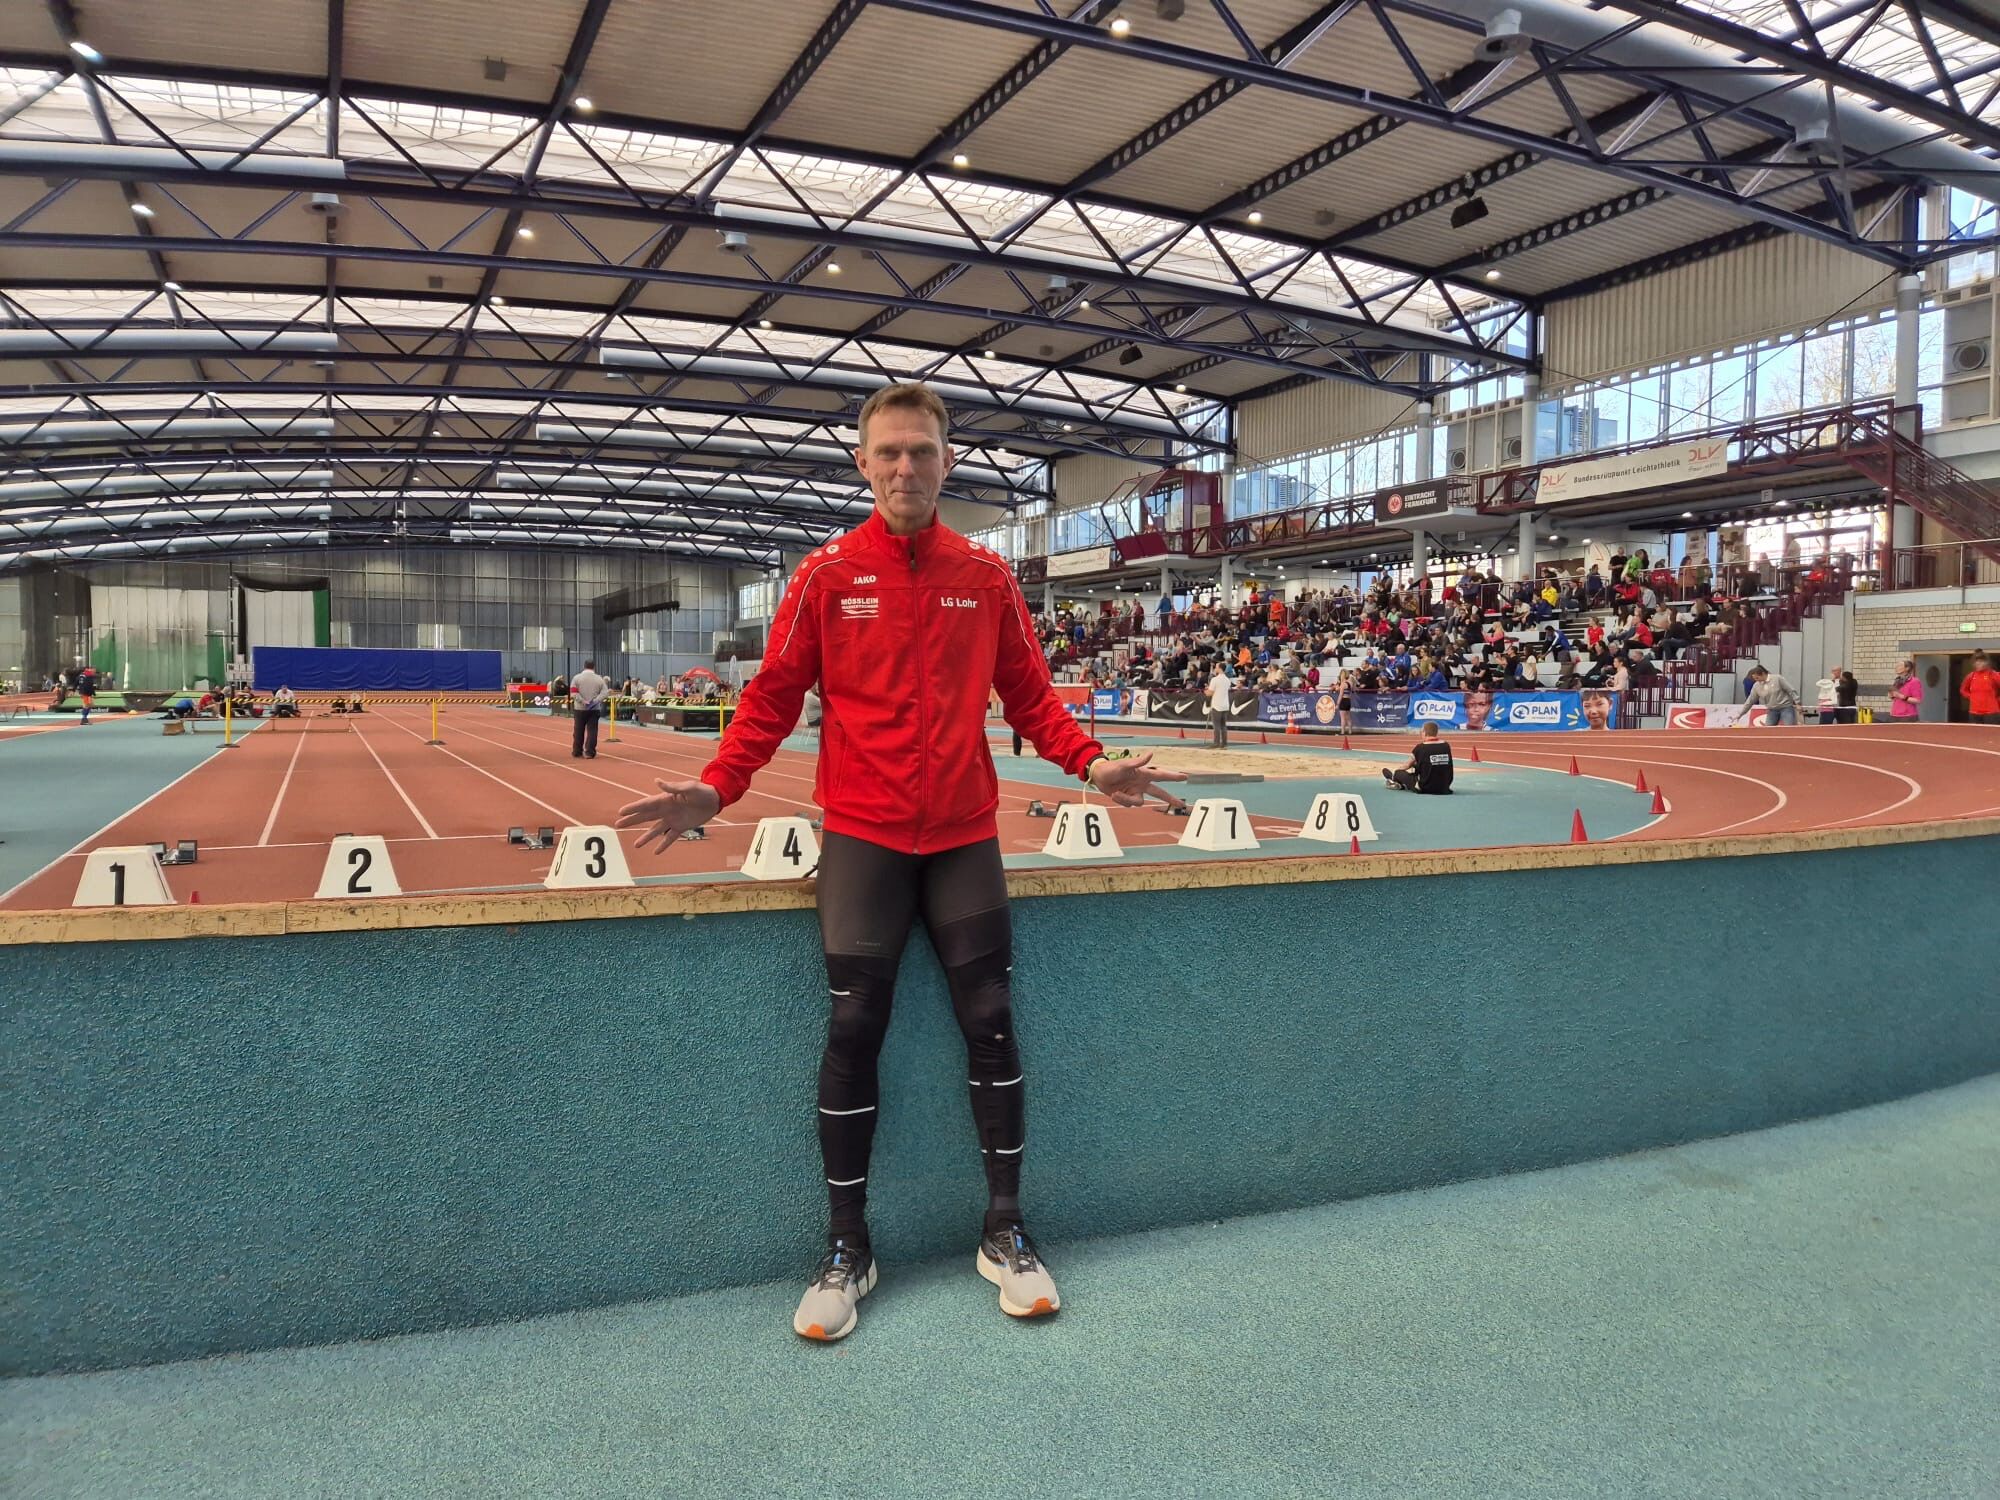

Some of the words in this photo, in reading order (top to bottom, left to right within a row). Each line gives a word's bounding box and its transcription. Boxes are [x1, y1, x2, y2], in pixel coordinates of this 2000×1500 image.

[1404, 490, 1435, 502] EINTRACHT
[1404, 497, 1437, 509] FRANKFURT
[852, 575, 877, 585] JAKO
[940, 596, 954, 607] LG
[955, 597, 978, 609] Lohr
[1429, 703, 1454, 713] PLAN
[1531, 705, 1558, 716] PLAN
[1056, 811, 1069, 846] 6
[1084, 812, 1102, 848] 6
[1195, 806, 1210, 838] 7
[1223, 806, 1237, 840] 7
[1315, 799, 1329, 831] 8
[1345, 800, 1360, 832] 8
[554, 835, 568, 877] 3
[584, 836, 607, 879] 3
[754, 826, 766, 865] 4
[782, 827, 803, 866] 4
[109, 861, 126, 905] 1
[347, 847, 372, 893] 2
